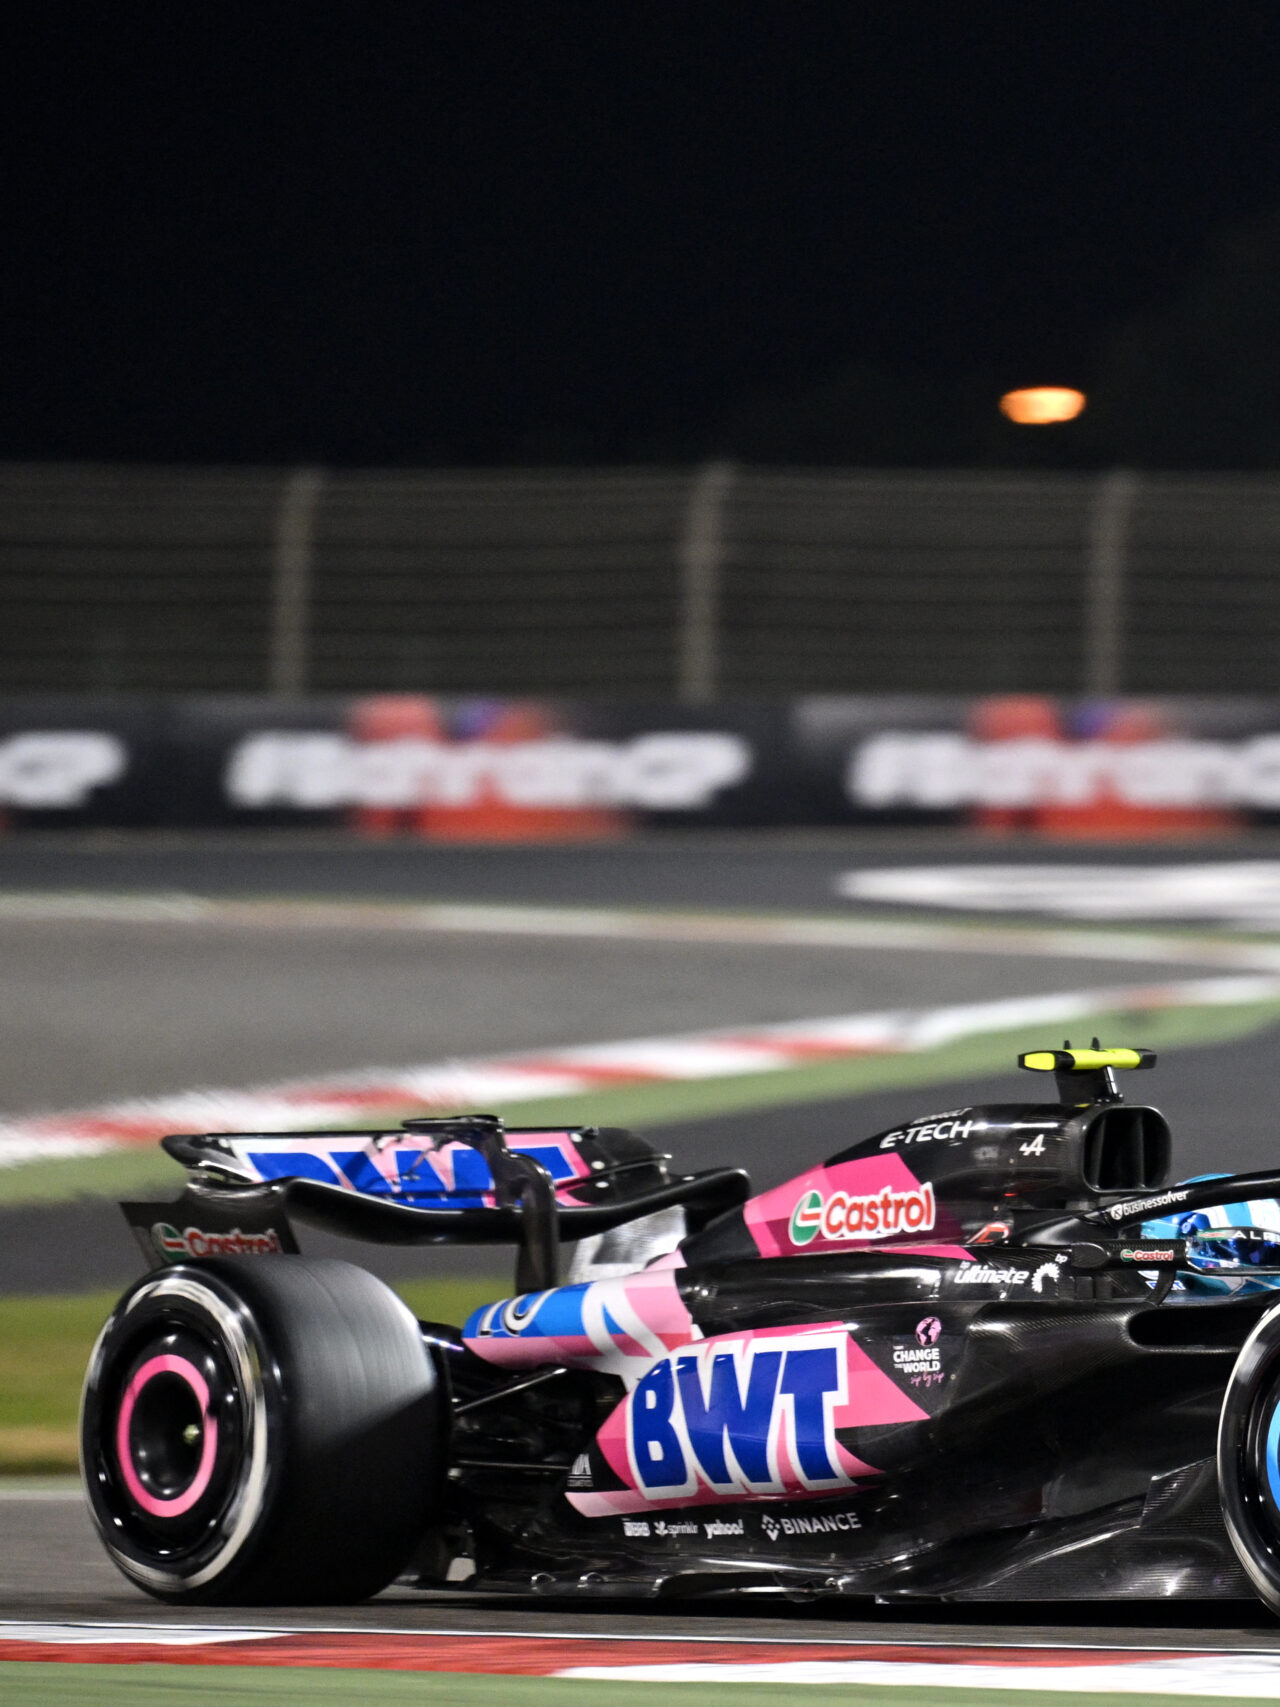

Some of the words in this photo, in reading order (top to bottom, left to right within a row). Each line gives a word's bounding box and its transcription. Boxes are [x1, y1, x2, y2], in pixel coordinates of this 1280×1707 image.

[879, 1120, 973, 1149] E-TECH
[823, 1184, 935, 1239] Castrol
[1122, 1189, 1188, 1216] businessolver
[185, 1229, 281, 1258] Castrol
[1132, 1250, 1174, 1261] Castrol
[954, 1265, 1029, 1285] ultimate
[893, 1348, 940, 1362] CHANGE
[903, 1361, 941, 1373] WORLD
[629, 1342, 846, 1491] BWT
[703, 1519, 744, 1540] yahoo!
[782, 1512, 862, 1535] BINANCE
